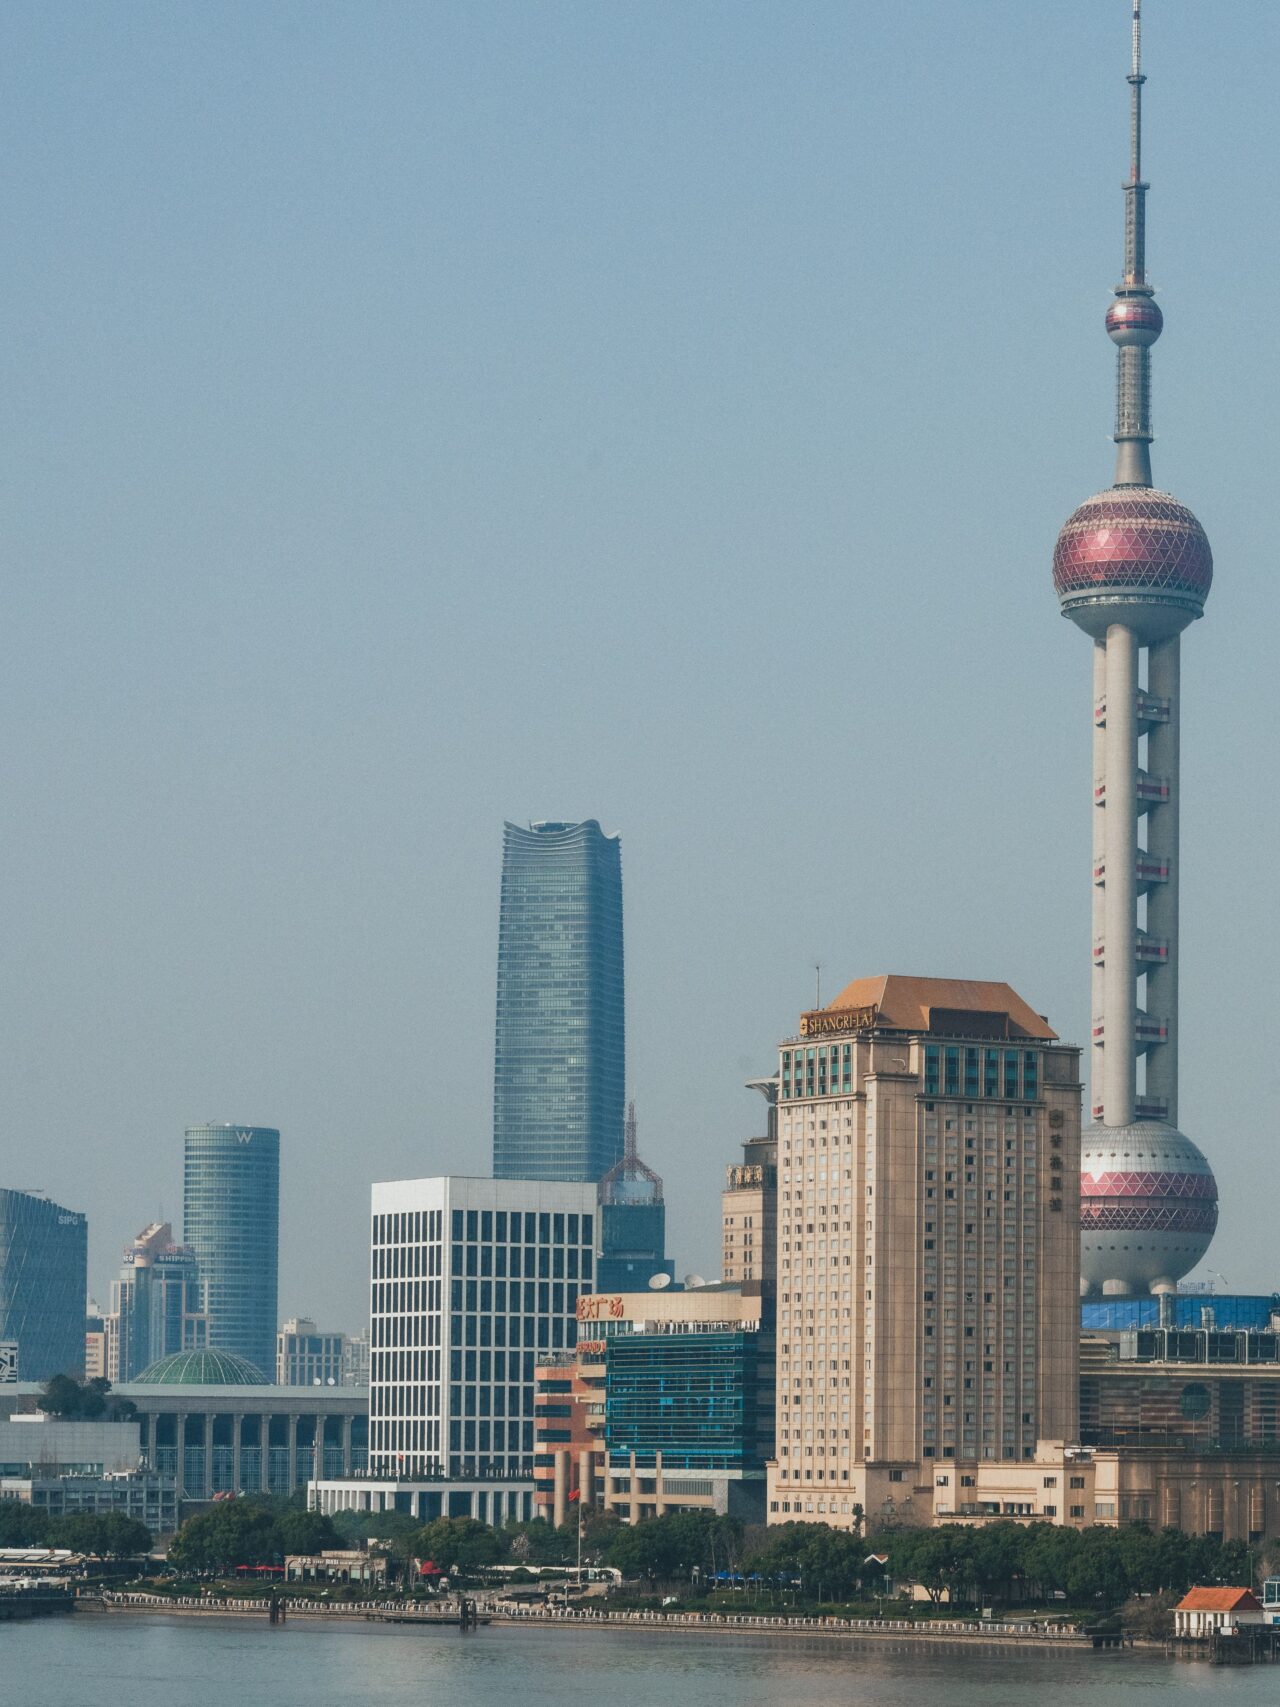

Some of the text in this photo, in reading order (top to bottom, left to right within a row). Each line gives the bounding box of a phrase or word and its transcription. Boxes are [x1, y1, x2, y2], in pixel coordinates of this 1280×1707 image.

[809, 1012, 870, 1033] SHANGRI-LA
[235, 1131, 253, 1144] W
[58, 1215, 78, 1225] SIPG
